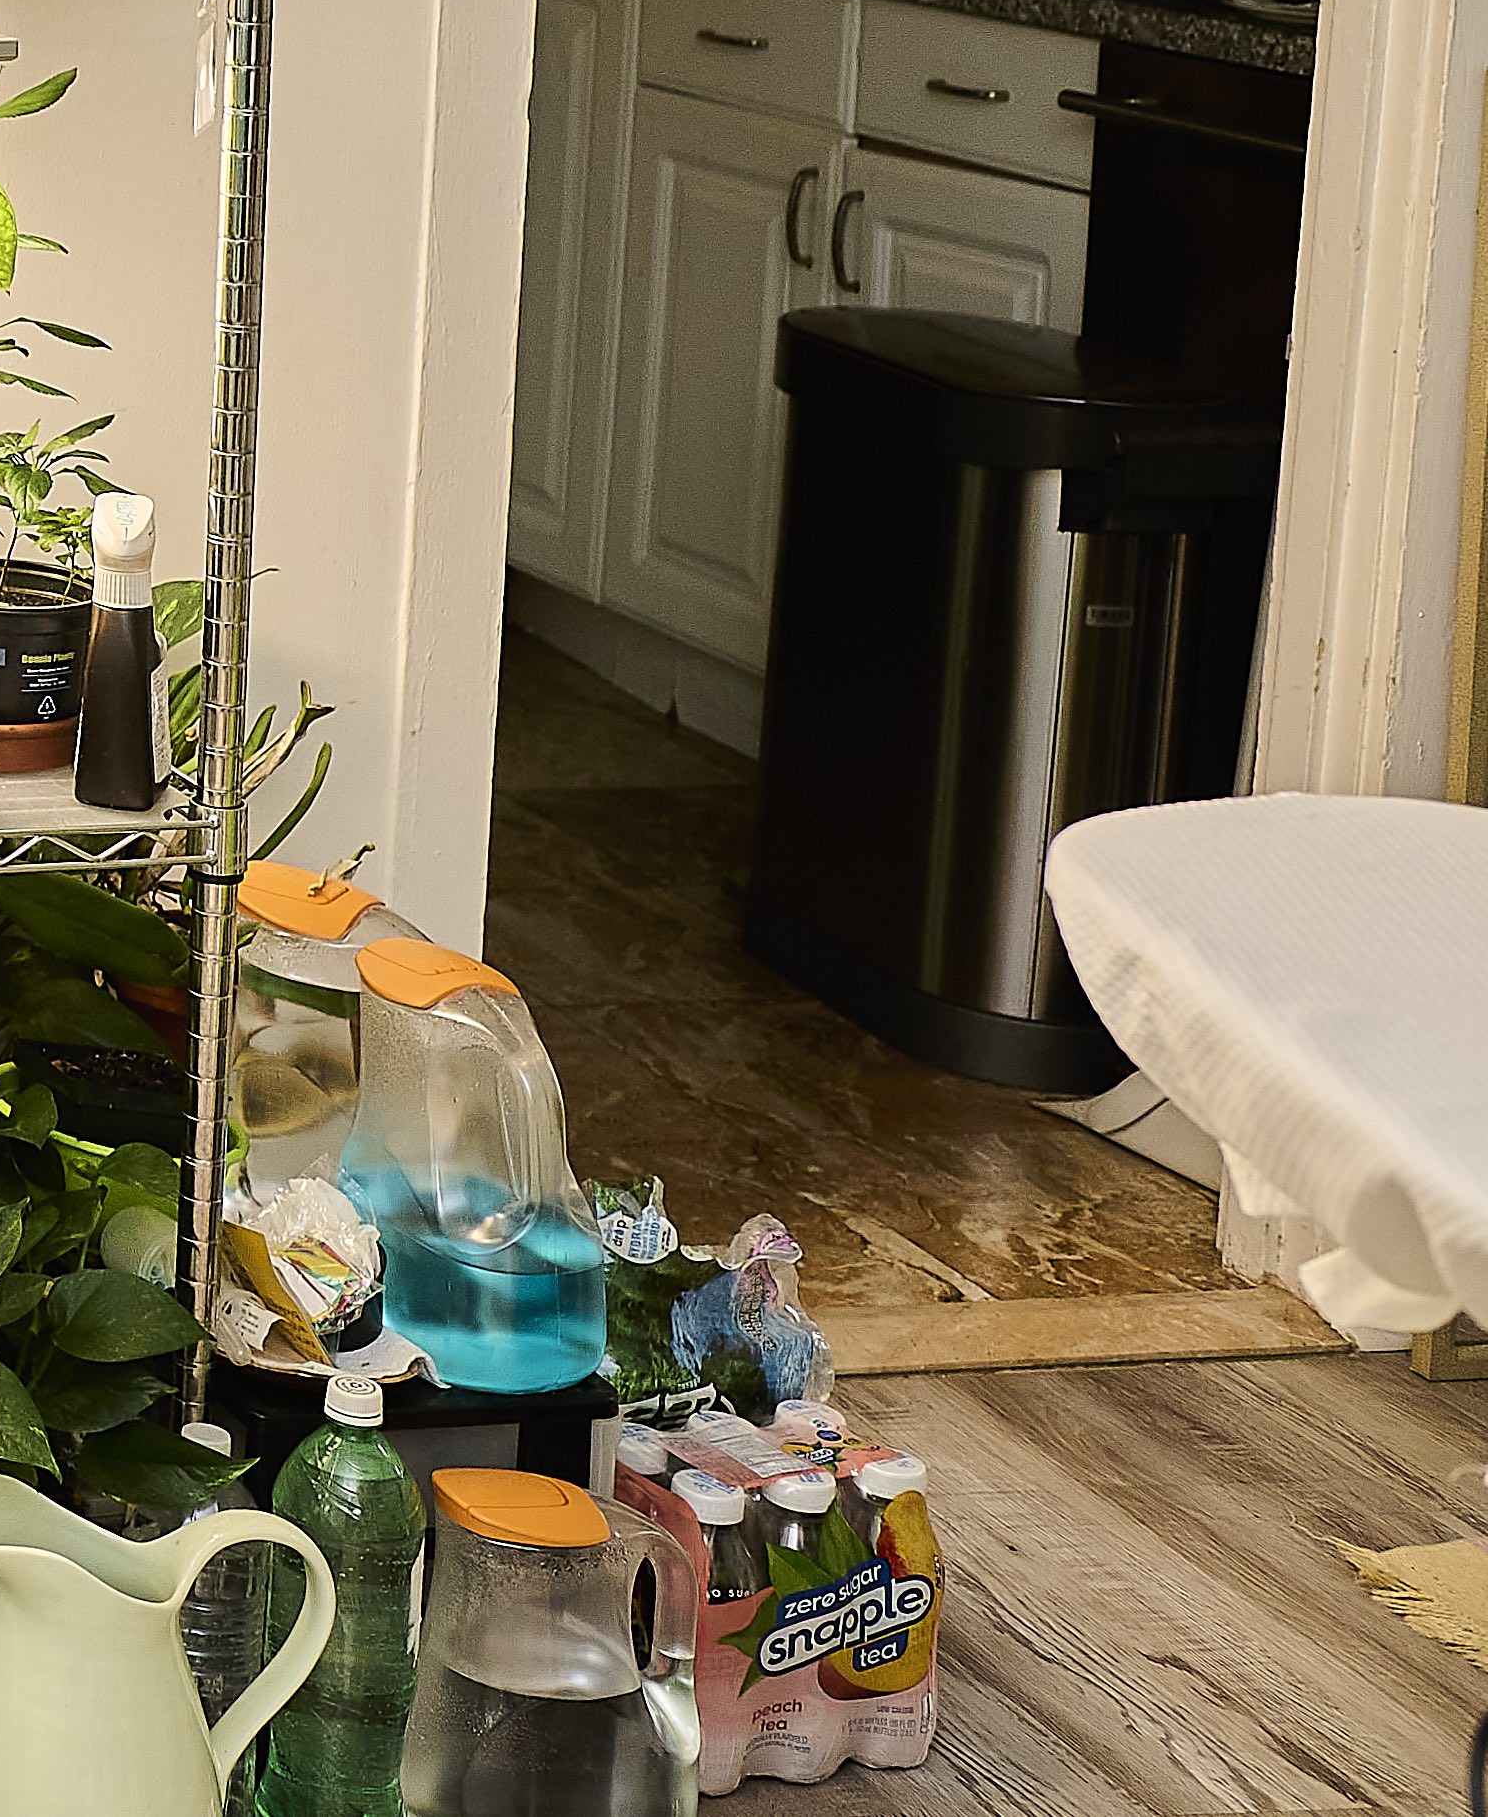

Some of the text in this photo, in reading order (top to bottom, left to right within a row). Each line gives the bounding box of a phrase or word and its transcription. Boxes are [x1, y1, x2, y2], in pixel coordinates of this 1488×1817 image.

[784, 1564, 882, 1620] zero sugar
[768, 1579, 928, 1666] snapple
[860, 1641, 898, 1667] tea
[752, 1698, 803, 1725] peach
[760, 1717, 787, 1733] tea
